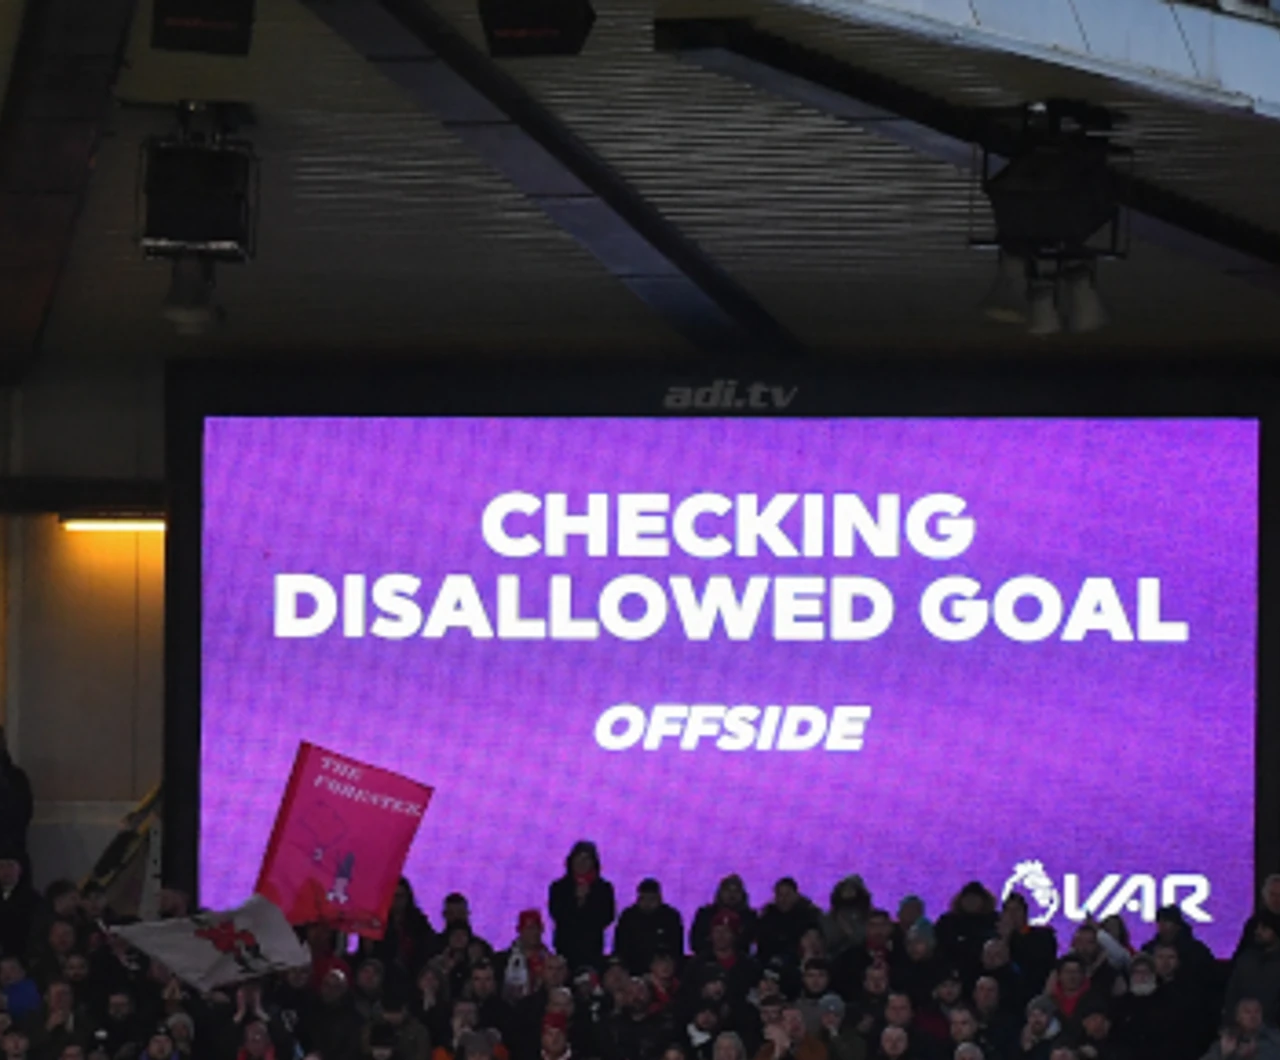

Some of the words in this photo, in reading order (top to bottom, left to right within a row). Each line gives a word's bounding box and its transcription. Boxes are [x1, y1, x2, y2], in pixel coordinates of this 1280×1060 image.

[663, 379, 799, 409] adi.tv
[481, 490, 977, 560] CHECKING
[273, 572, 895, 641] DISALLOWED
[919, 573, 1190, 643] GOAL
[593, 702, 873, 752] OFFSIDE
[321, 756, 362, 781] THE
[1063, 873, 1213, 922] VAR
